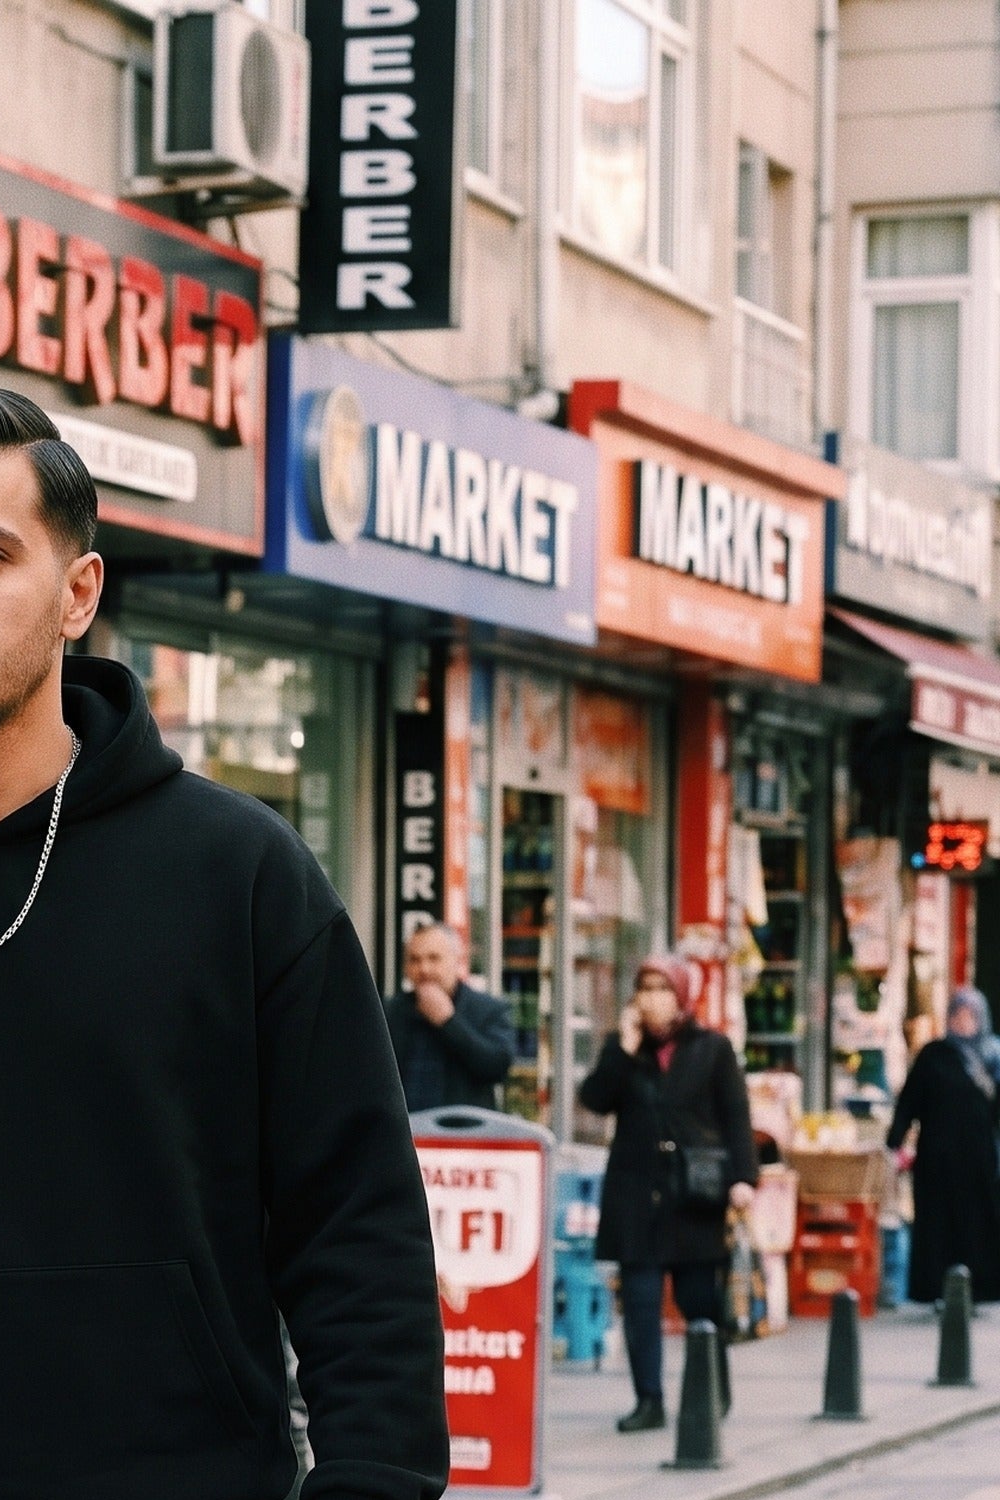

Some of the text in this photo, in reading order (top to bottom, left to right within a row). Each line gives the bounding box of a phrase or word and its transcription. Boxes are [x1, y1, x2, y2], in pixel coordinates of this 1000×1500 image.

[336, 0, 420, 310] BERBER
[375, 422, 579, 588] MARKET
[639, 460, 810, 606] MARKET
